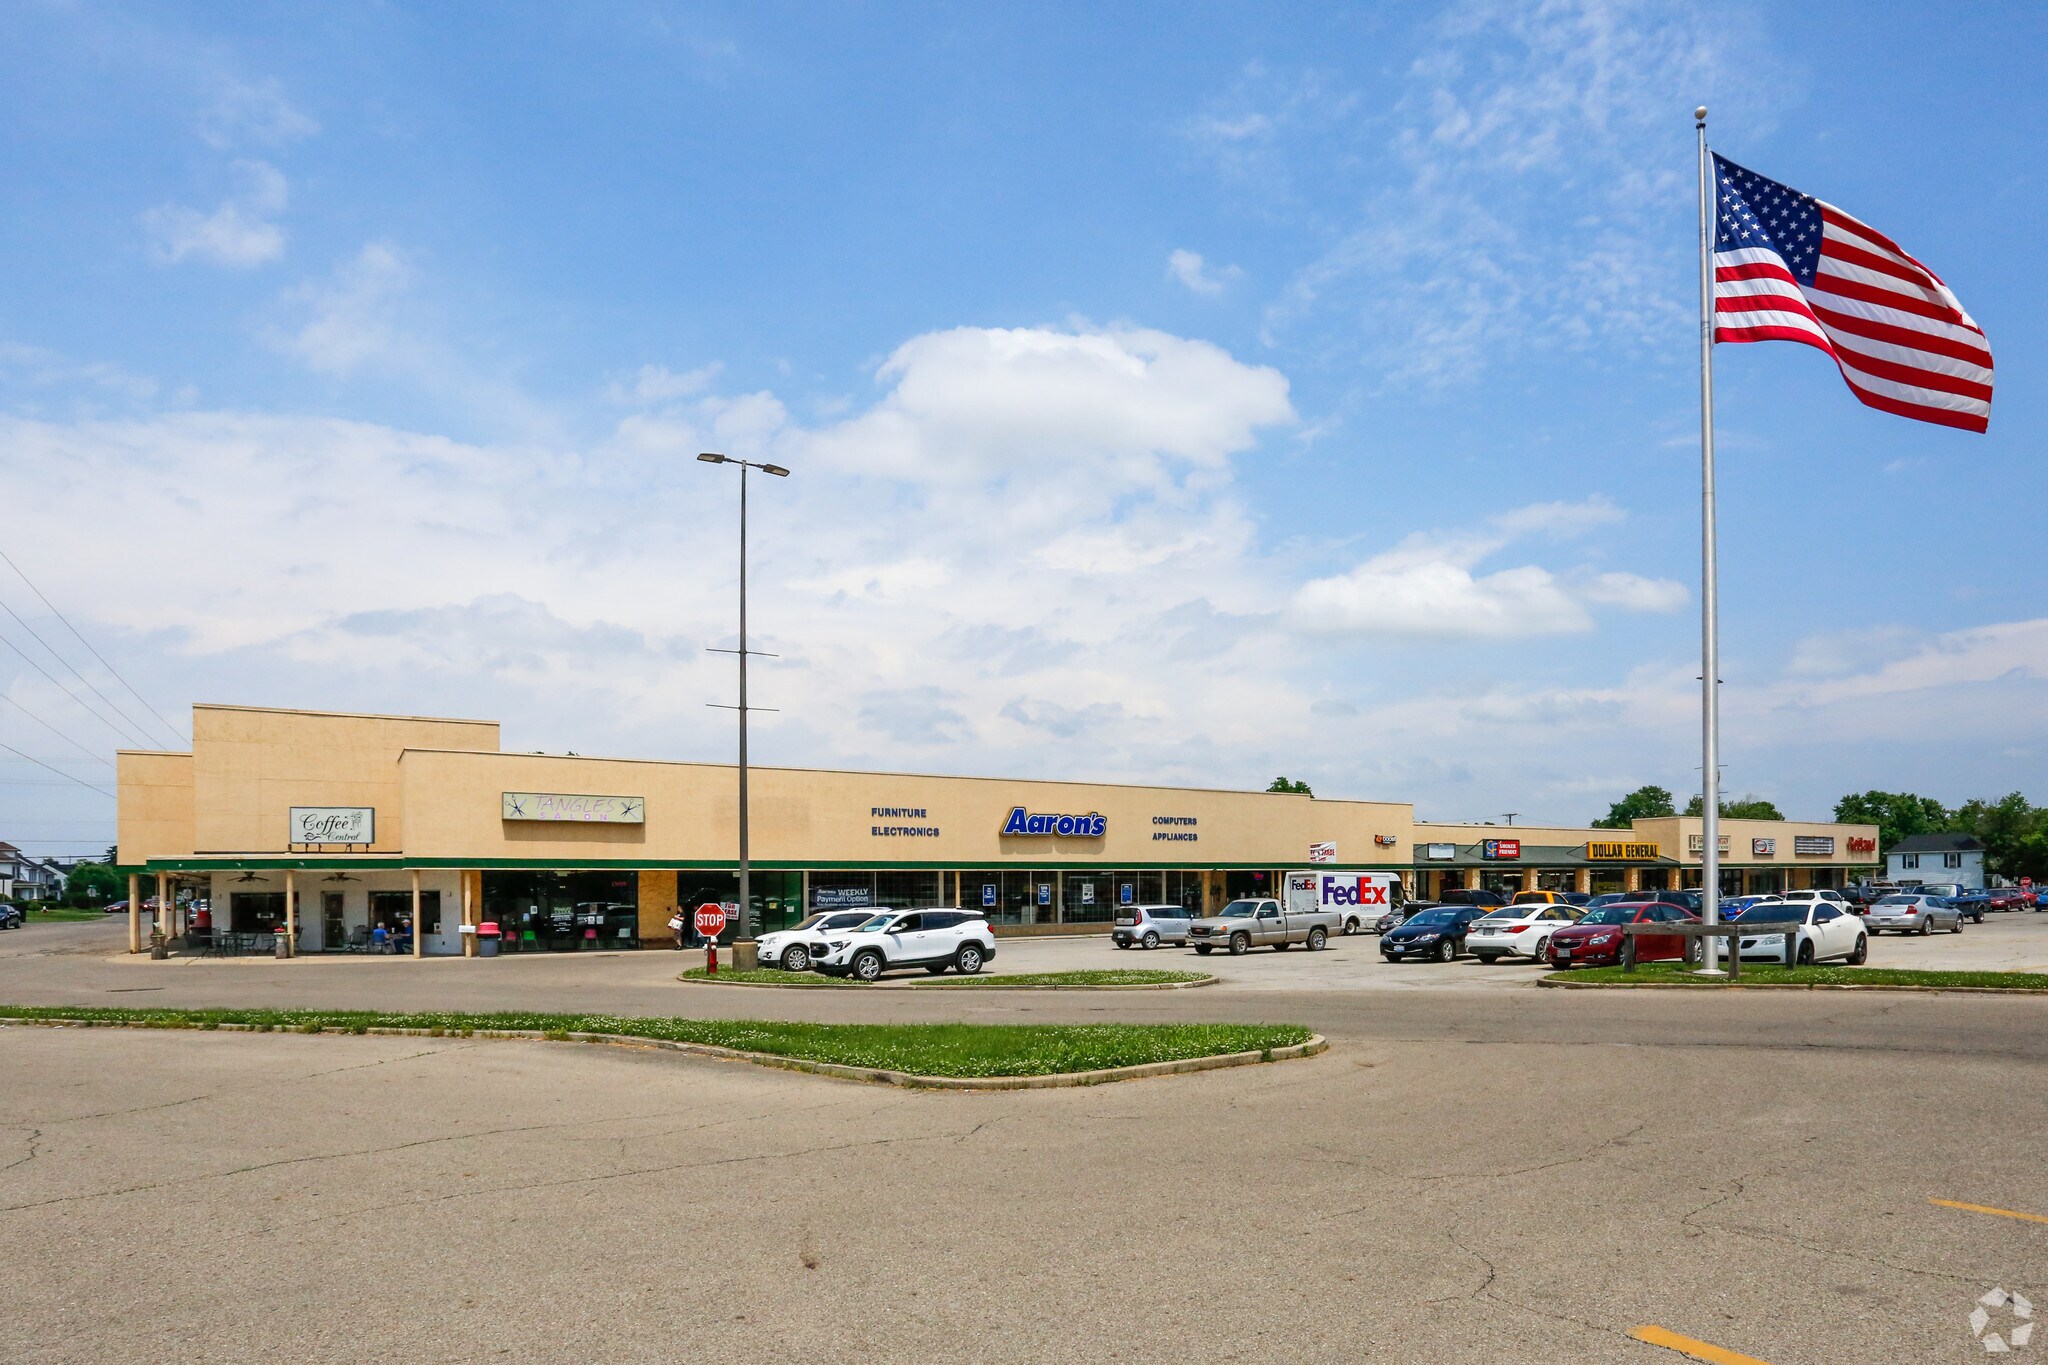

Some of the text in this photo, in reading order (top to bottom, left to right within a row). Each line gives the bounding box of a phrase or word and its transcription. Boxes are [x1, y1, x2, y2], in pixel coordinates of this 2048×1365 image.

[535, 794, 615, 812] TANGLES
[540, 812, 607, 821] SALON
[871, 807, 927, 818] FURNITURE
[299, 813, 349, 835] Coffee
[1001, 807, 1107, 837] Aaron's
[1152, 816, 1197, 825] COMPUTERS
[327, 831, 361, 841] Central
[871, 826, 940, 837] ELECTRONICS
[1152, 832, 1198, 841] APPLIANCES
[1592, 843, 1659, 858] DOLLAR GENERAL
[1291, 879, 1316, 890] FedEx
[838, 888, 868, 896] WEEKLY
[1323, 876, 1387, 905] FedEx
[817, 895, 846, 903] Payment
[696, 914, 723, 926] STOP
